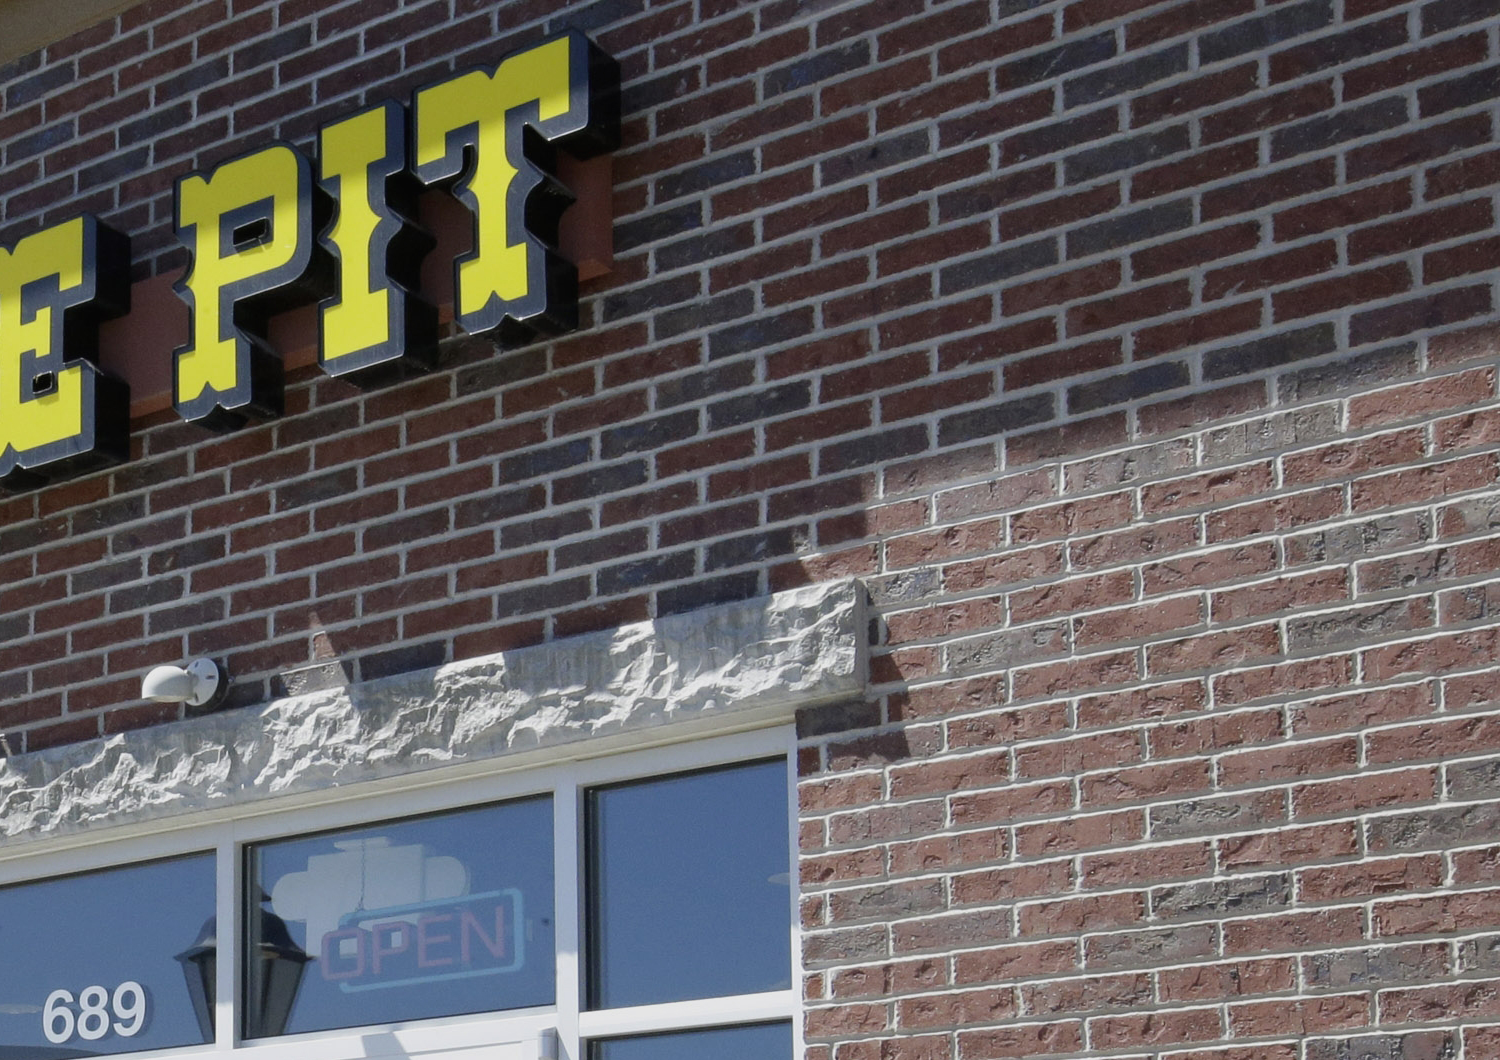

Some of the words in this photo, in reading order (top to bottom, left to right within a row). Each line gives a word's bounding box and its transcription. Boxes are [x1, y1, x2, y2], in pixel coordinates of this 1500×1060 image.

[172, 30, 589, 424] PIT
[321, 905, 506, 982] OPEN
[43, 981, 146, 1044] 689
